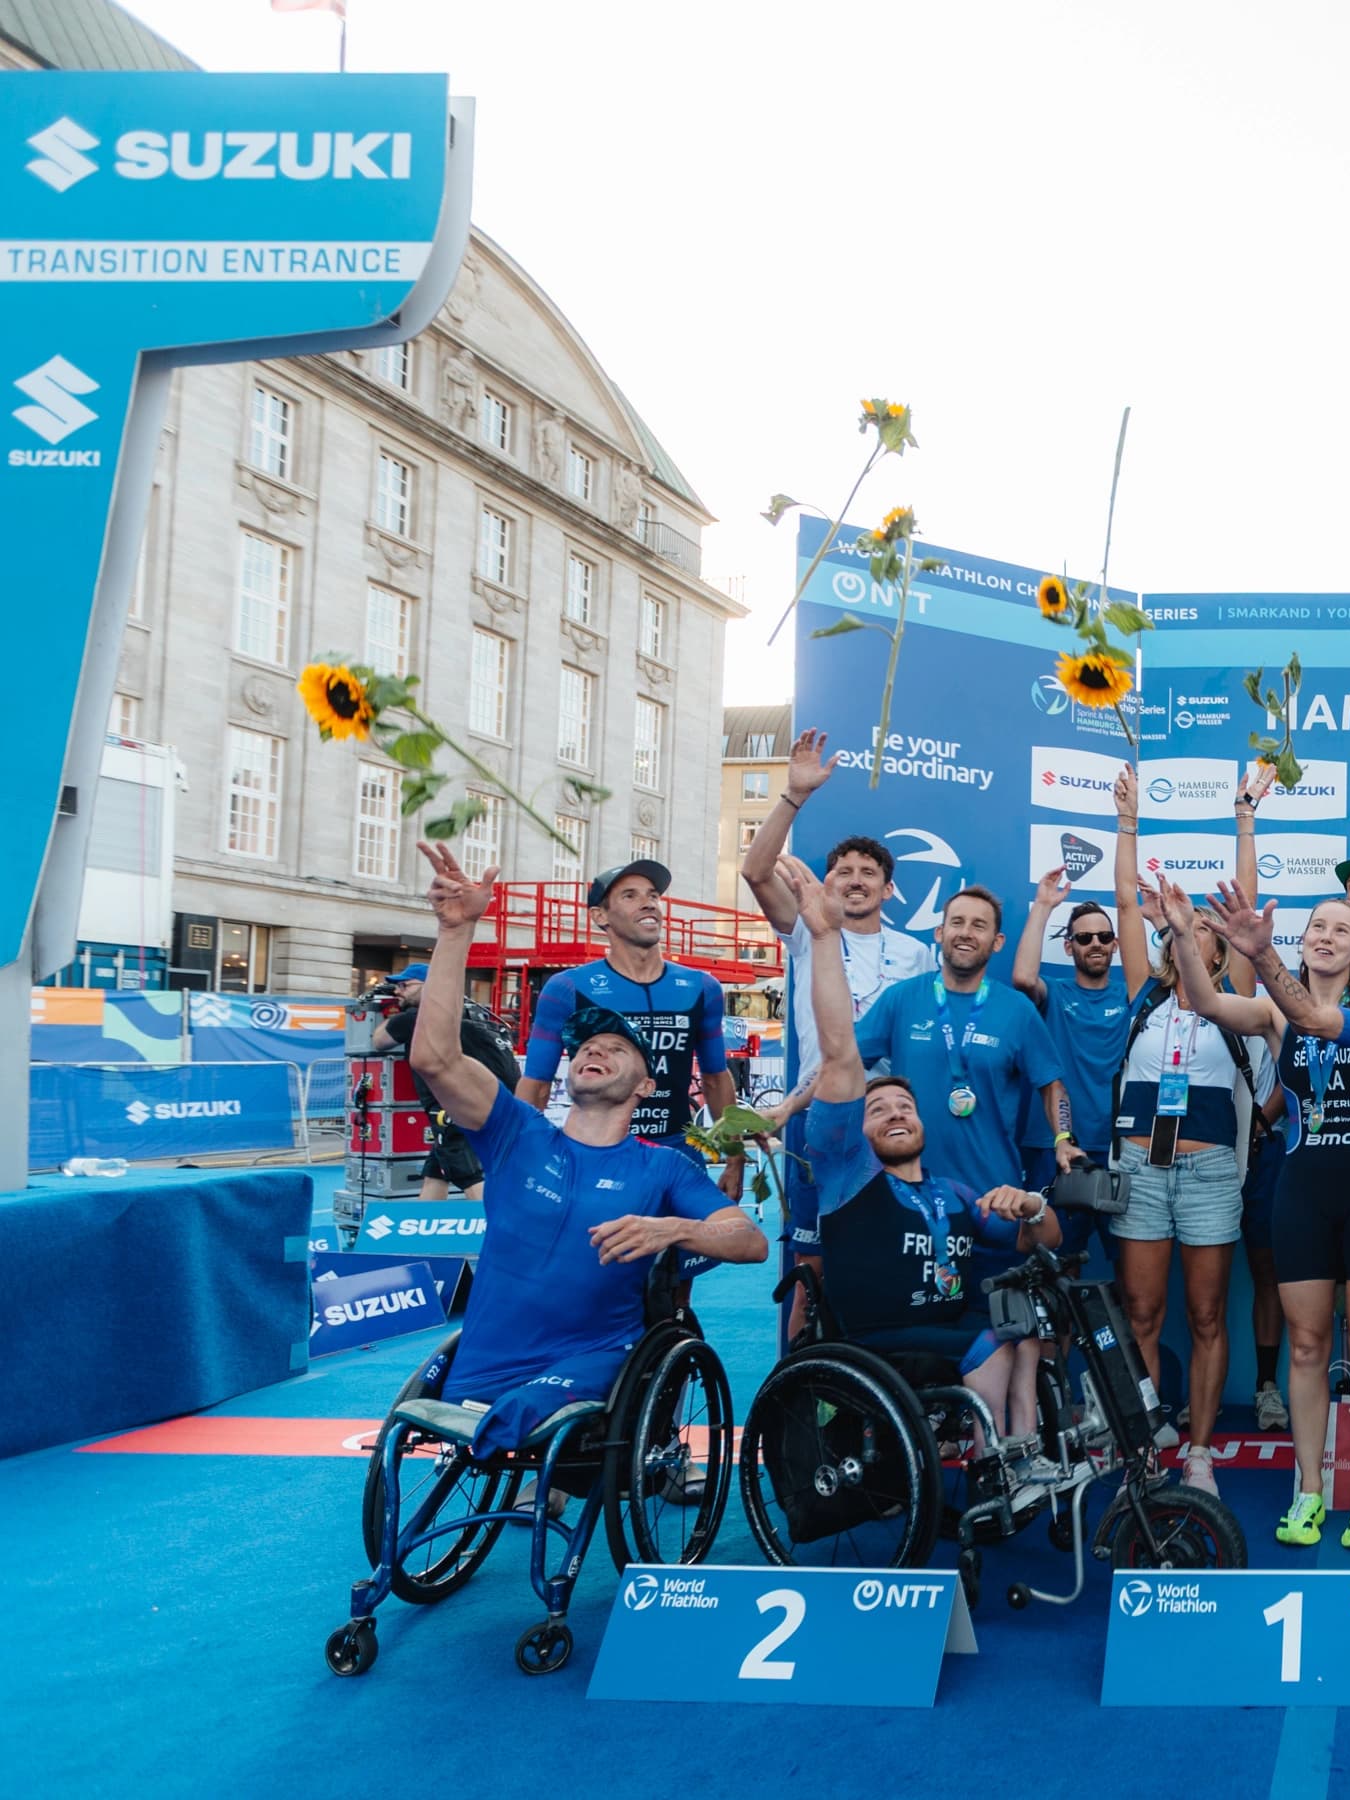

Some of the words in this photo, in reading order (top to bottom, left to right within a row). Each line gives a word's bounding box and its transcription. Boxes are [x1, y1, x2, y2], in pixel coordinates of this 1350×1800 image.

[114, 130, 412, 180] SUZUKI
[7, 247, 208, 275] TRANSITION
[222, 247, 402, 275] ENTRANCE
[8, 449, 101, 467] SUZUKI
[1146, 607, 1199, 622] SERIES
[1227, 606, 1311, 620] SMARKAND
[906, 736, 963, 760] your
[1059, 774, 1112, 793] SUZUK
[1178, 781, 1229, 791] HAMBURG
[1274, 785, 1336, 797] SUZUKI
[1178, 789, 1218, 800] WASSER
[1065, 852, 1097, 863] ACTIVE
[1164, 858, 1225, 871] SUZUKI
[1287, 857, 1338, 867] HAMBURG
[1066, 862, 1087, 872] CITY
[1287, 865, 1327, 876] WASSER
[154, 1100, 242, 1120] SUZUKI
[903, 1231, 974, 1257] FRISCH
[325, 1287, 427, 1327] SUZUKI
[663, 1578, 706, 1594] World
[1157, 1583, 1200, 1598] World
[660, 1592, 719, 1610] Triathlon
[886, 1584, 944, 1609] NTT
[1156, 1597, 1217, 1614] Triathlon
[738, 1588, 806, 1680] 2
[1262, 1591, 1304, 1683] 1
